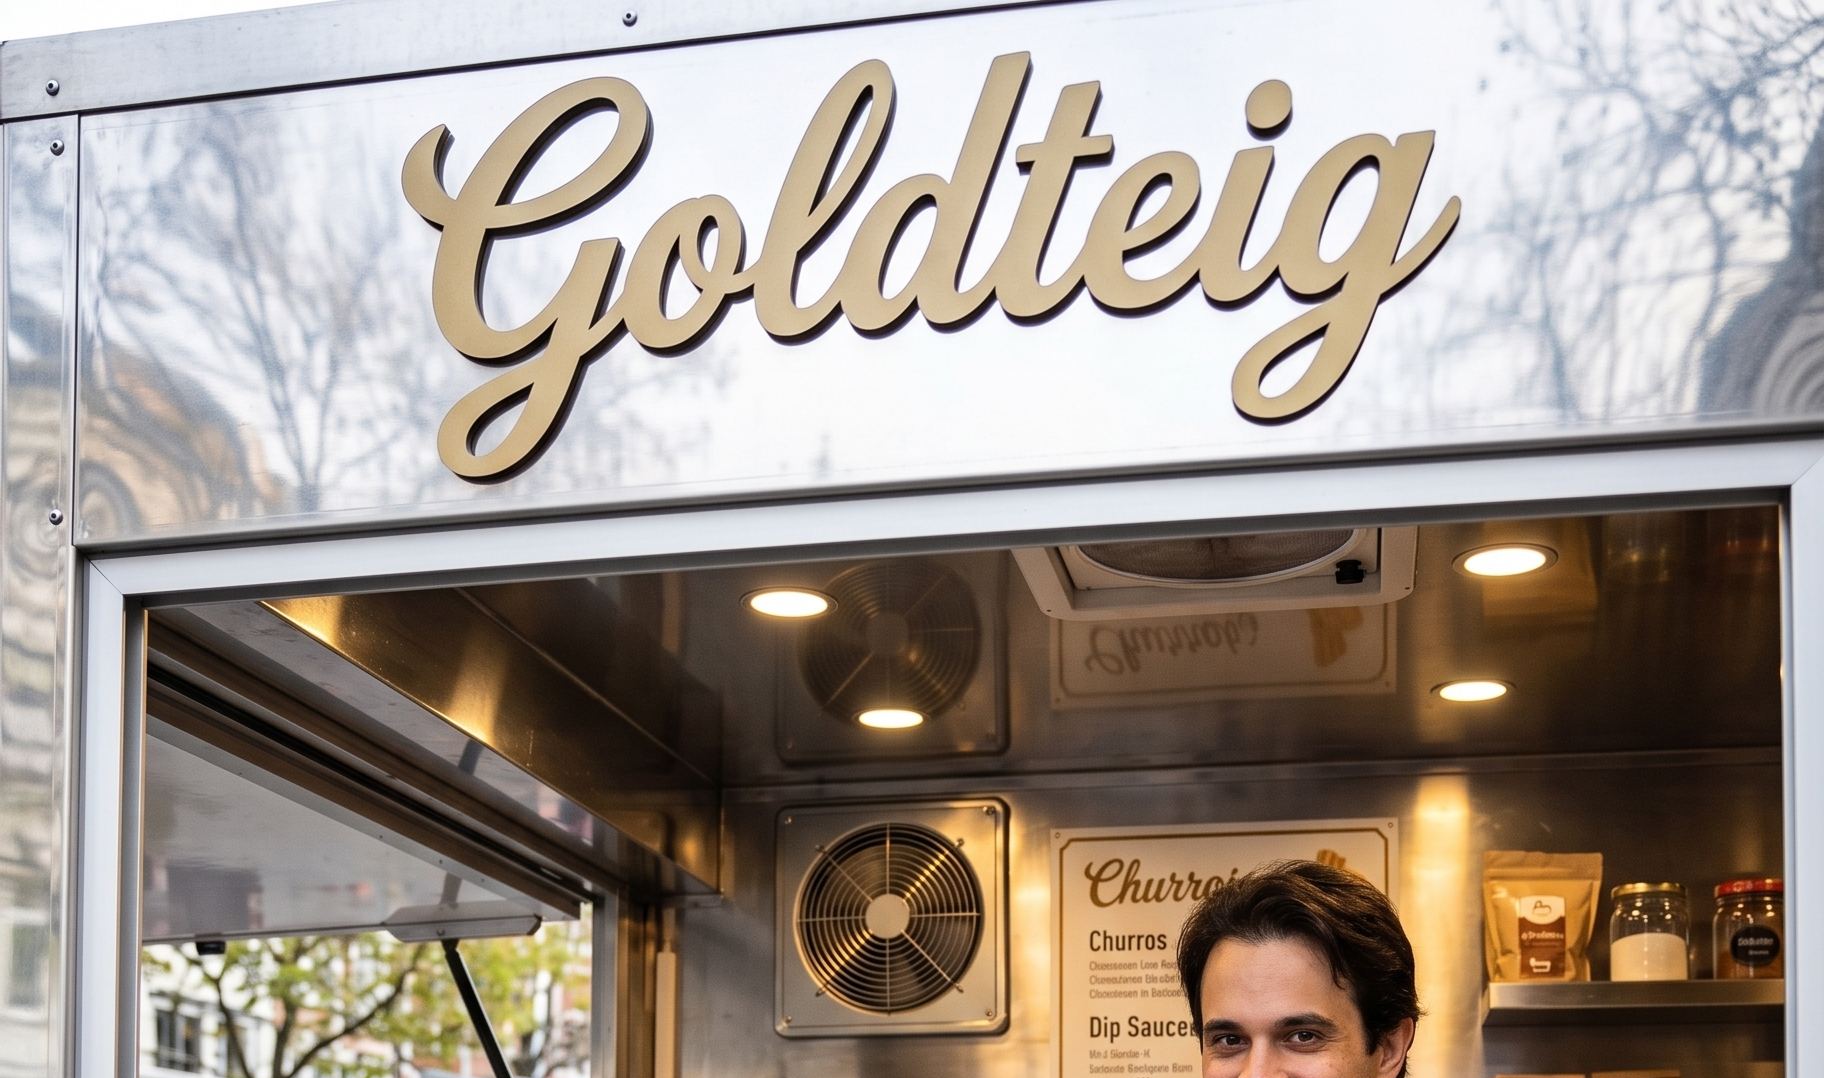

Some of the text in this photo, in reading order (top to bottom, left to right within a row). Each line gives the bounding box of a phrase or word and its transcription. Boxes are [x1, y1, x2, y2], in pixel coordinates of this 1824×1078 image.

[401, 51, 1462, 481] Goldteig
[1089, 930, 1167, 952] Churros
[1090, 1016, 1121, 1044] Dip
